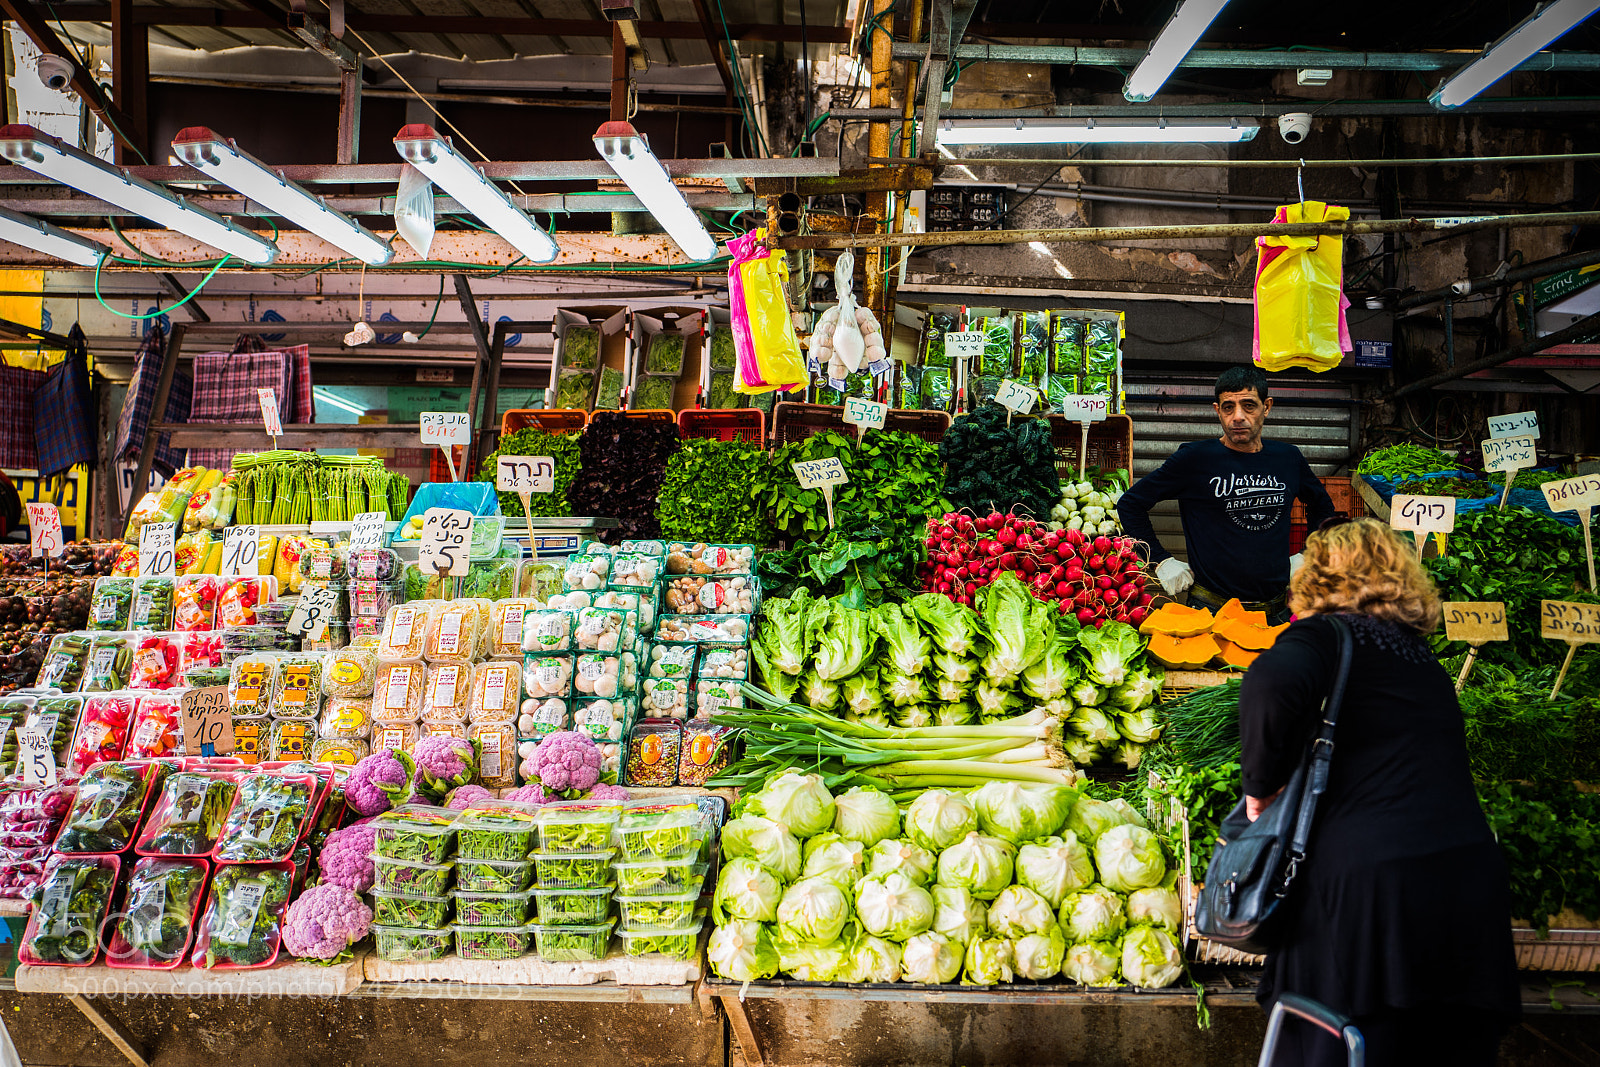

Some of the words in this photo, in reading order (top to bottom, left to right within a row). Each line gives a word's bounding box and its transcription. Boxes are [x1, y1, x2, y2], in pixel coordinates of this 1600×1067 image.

[847, 400, 881, 414] תרד
[501, 462, 552, 479] תרד
[1209, 473, 1281, 497] Warriors
[1226, 499, 1252, 509] ARMY
[1253, 495, 1284, 506] JEANS
[1402, 499, 1445, 526] רוקט
[428, 512, 471, 529] נבטים
[35, 530, 55, 550] 15
[143, 551, 172, 574] 10
[225, 540, 256, 575] 10
[432, 545, 460, 571] 5
[302, 607, 321, 629] 8
[1447, 609, 1504, 624] עירית
[193, 717, 224, 748] 10
[34, 754, 48, 778] 5
